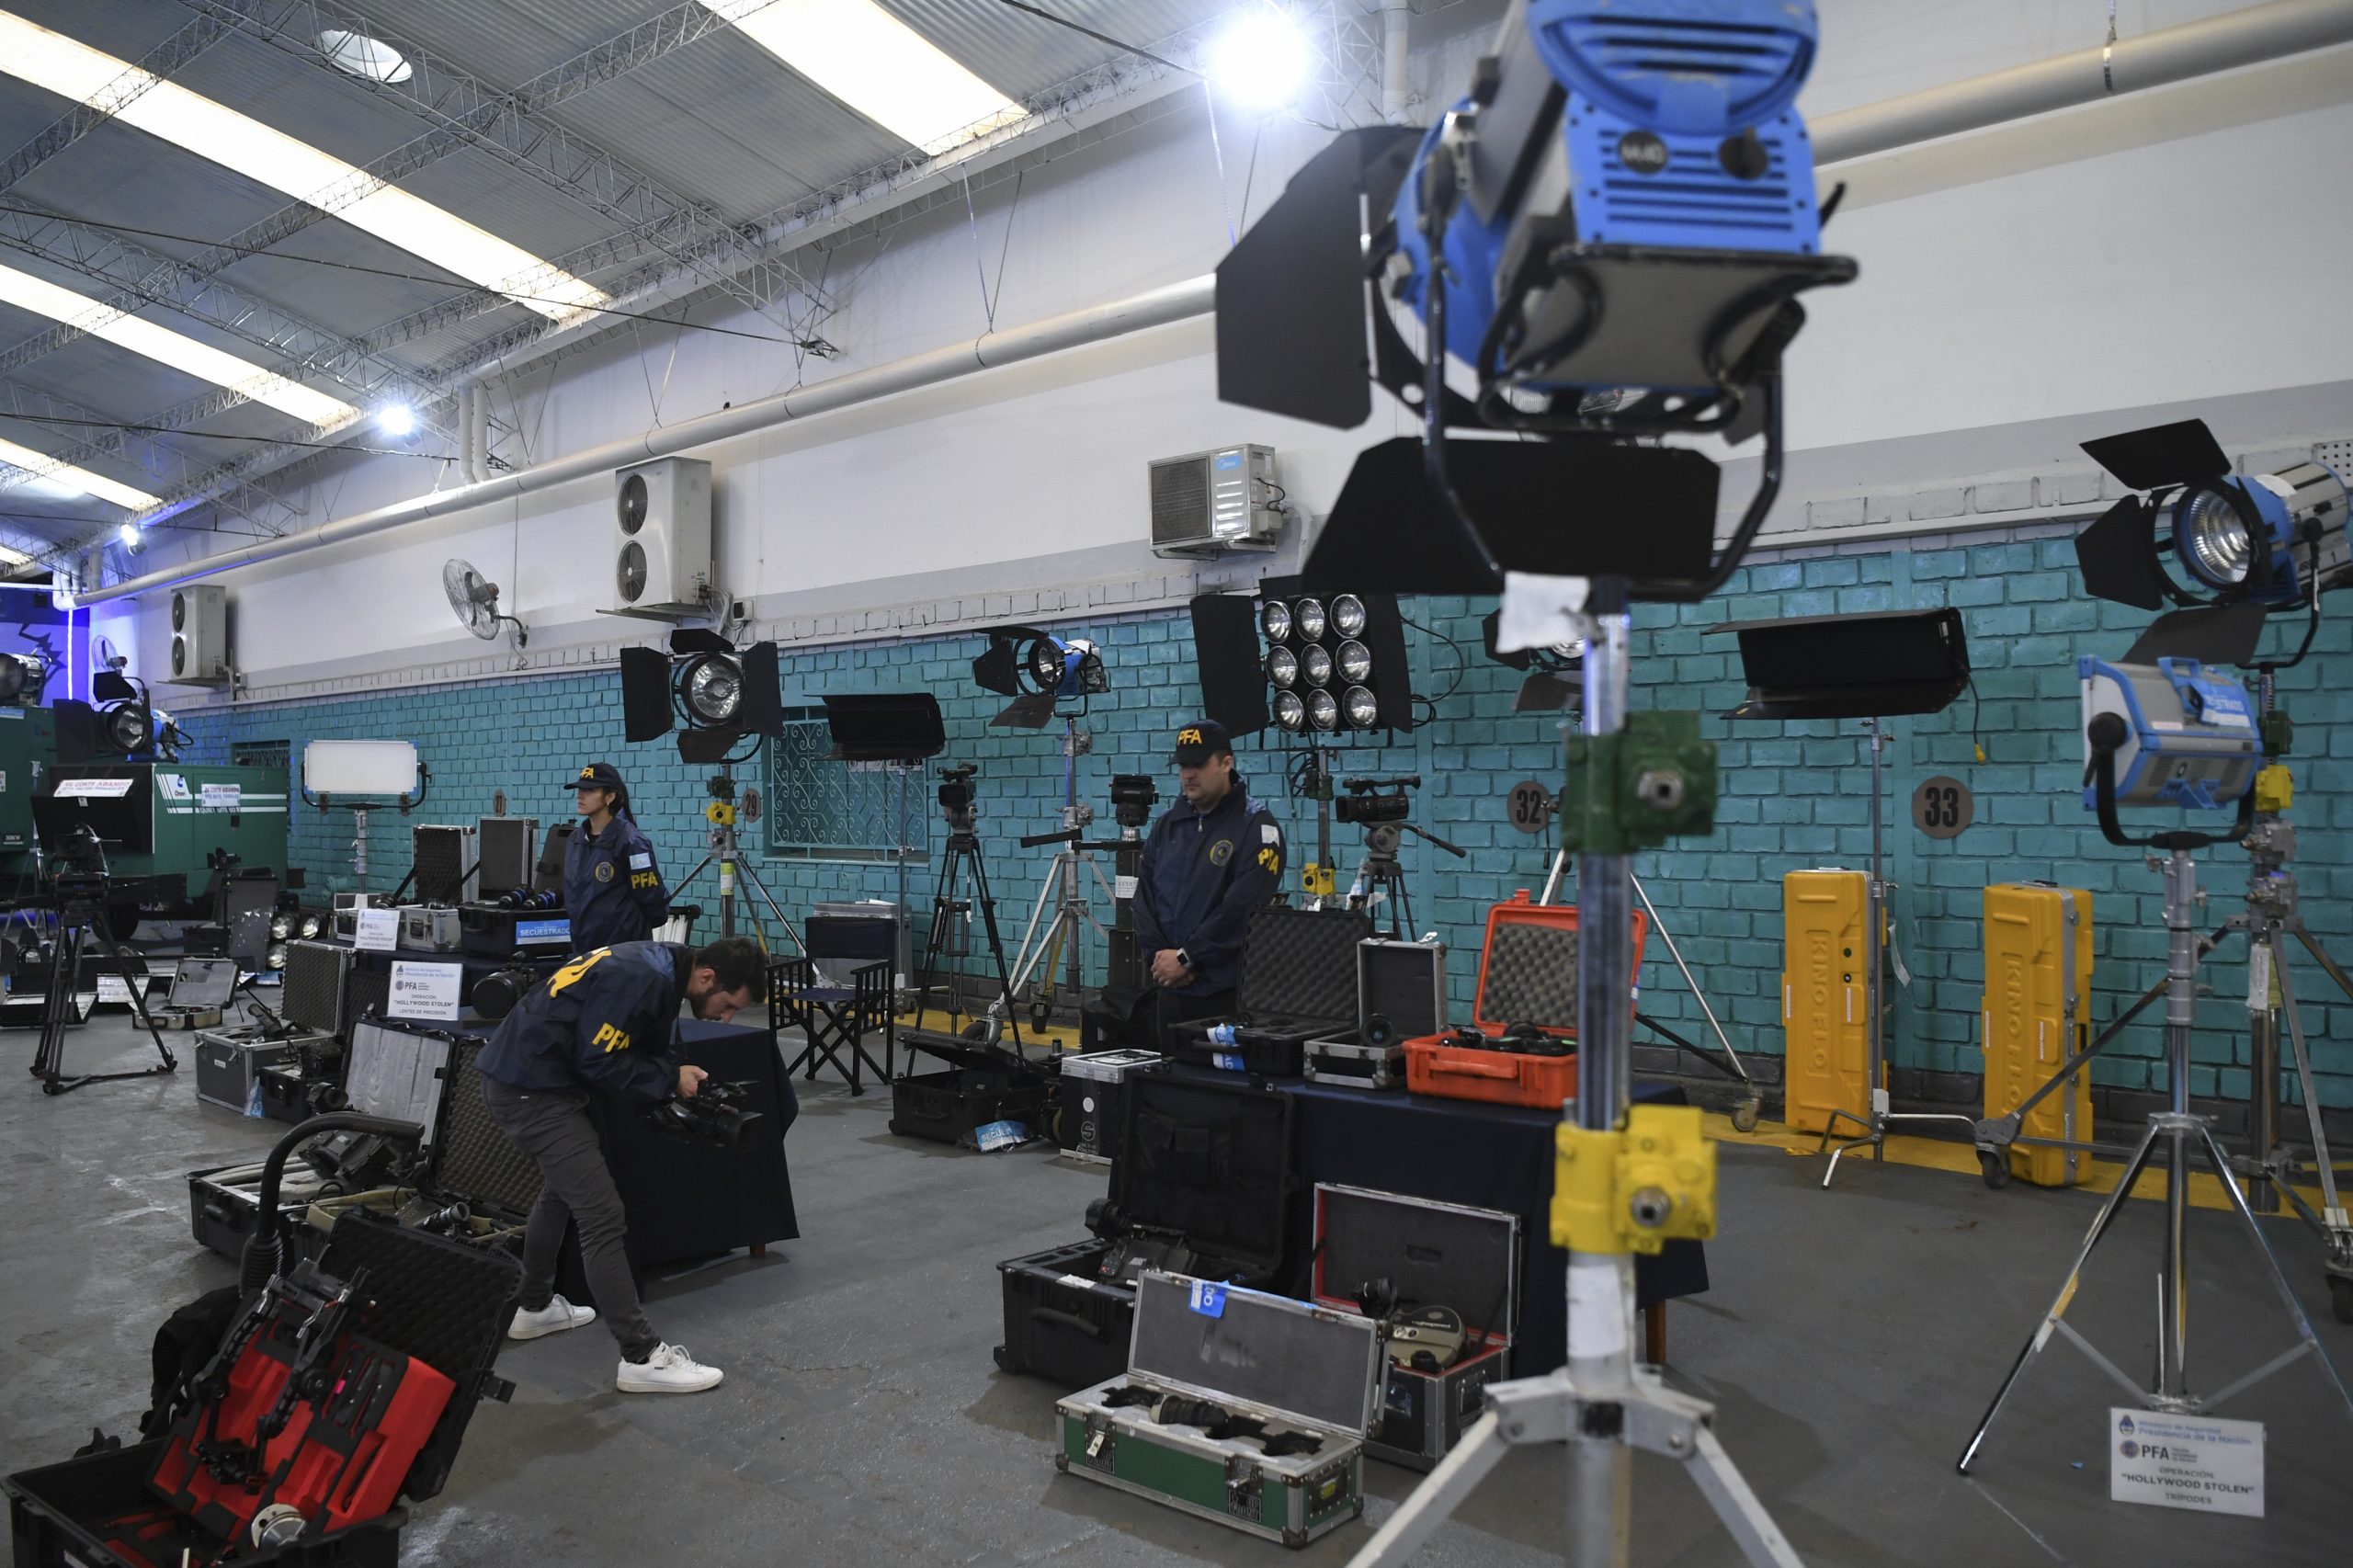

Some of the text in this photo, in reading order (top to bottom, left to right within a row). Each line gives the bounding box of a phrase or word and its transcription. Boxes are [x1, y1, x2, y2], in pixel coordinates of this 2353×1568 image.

[1177, 729, 1202, 745] PFA
[745, 793, 757, 817] 29
[1517, 790, 1541, 824] 32
[1925, 787, 1959, 827] 33
[631, 872, 658, 889] PFA
[520, 927, 570, 937] SECUESTRADO
[405, 982, 417, 990] PFA
[1812, 936, 1827, 1069] KINO FLO
[2007, 960, 2022, 1108] KINO FLO
[2139, 1428, 2192, 1440] Presidencia
[2142, 1445, 2170, 1460] PFA
[2121, 1473, 2255, 1494] "HOLLYWOOD STOLEN"
